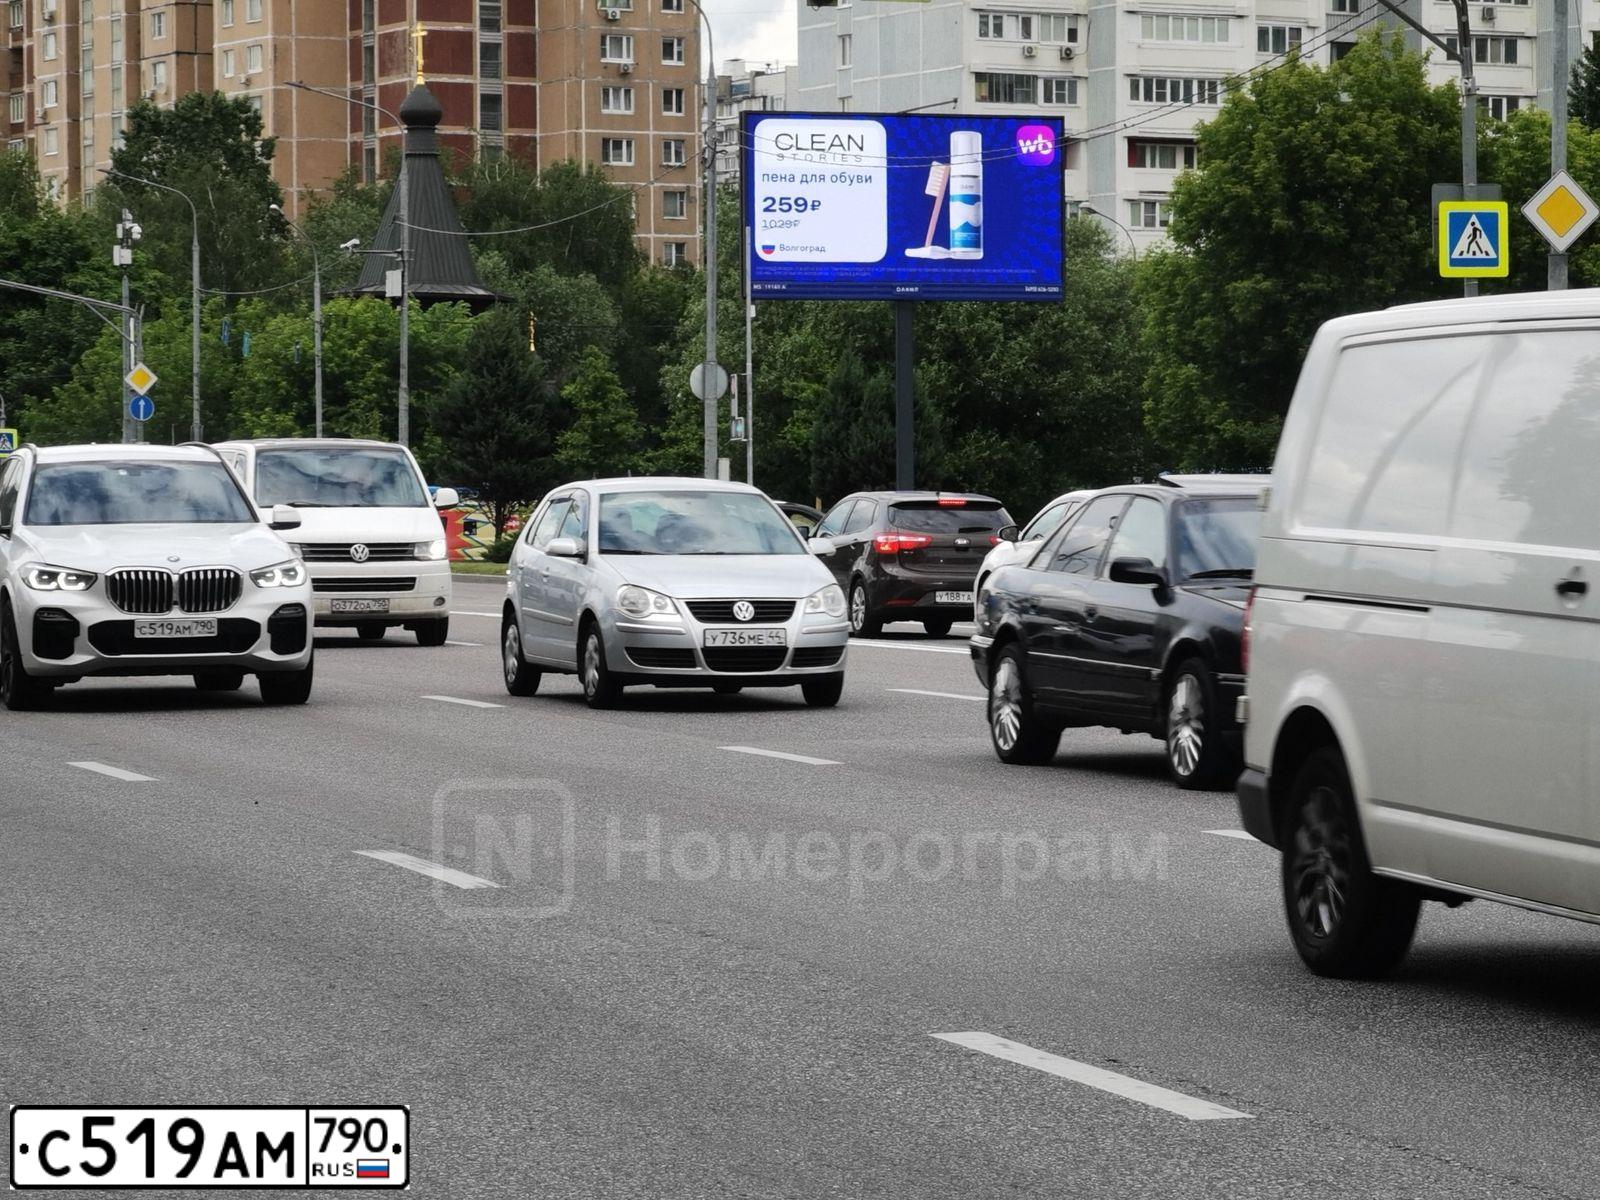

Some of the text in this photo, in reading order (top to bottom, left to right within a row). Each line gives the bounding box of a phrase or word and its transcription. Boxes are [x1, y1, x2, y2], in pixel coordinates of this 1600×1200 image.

[775, 133, 864, 151] CLEAN
[776, 153, 863, 162] STORIES
[762, 172, 873, 186] пена для обуви
[779, 244, 827, 253] Волгоград
